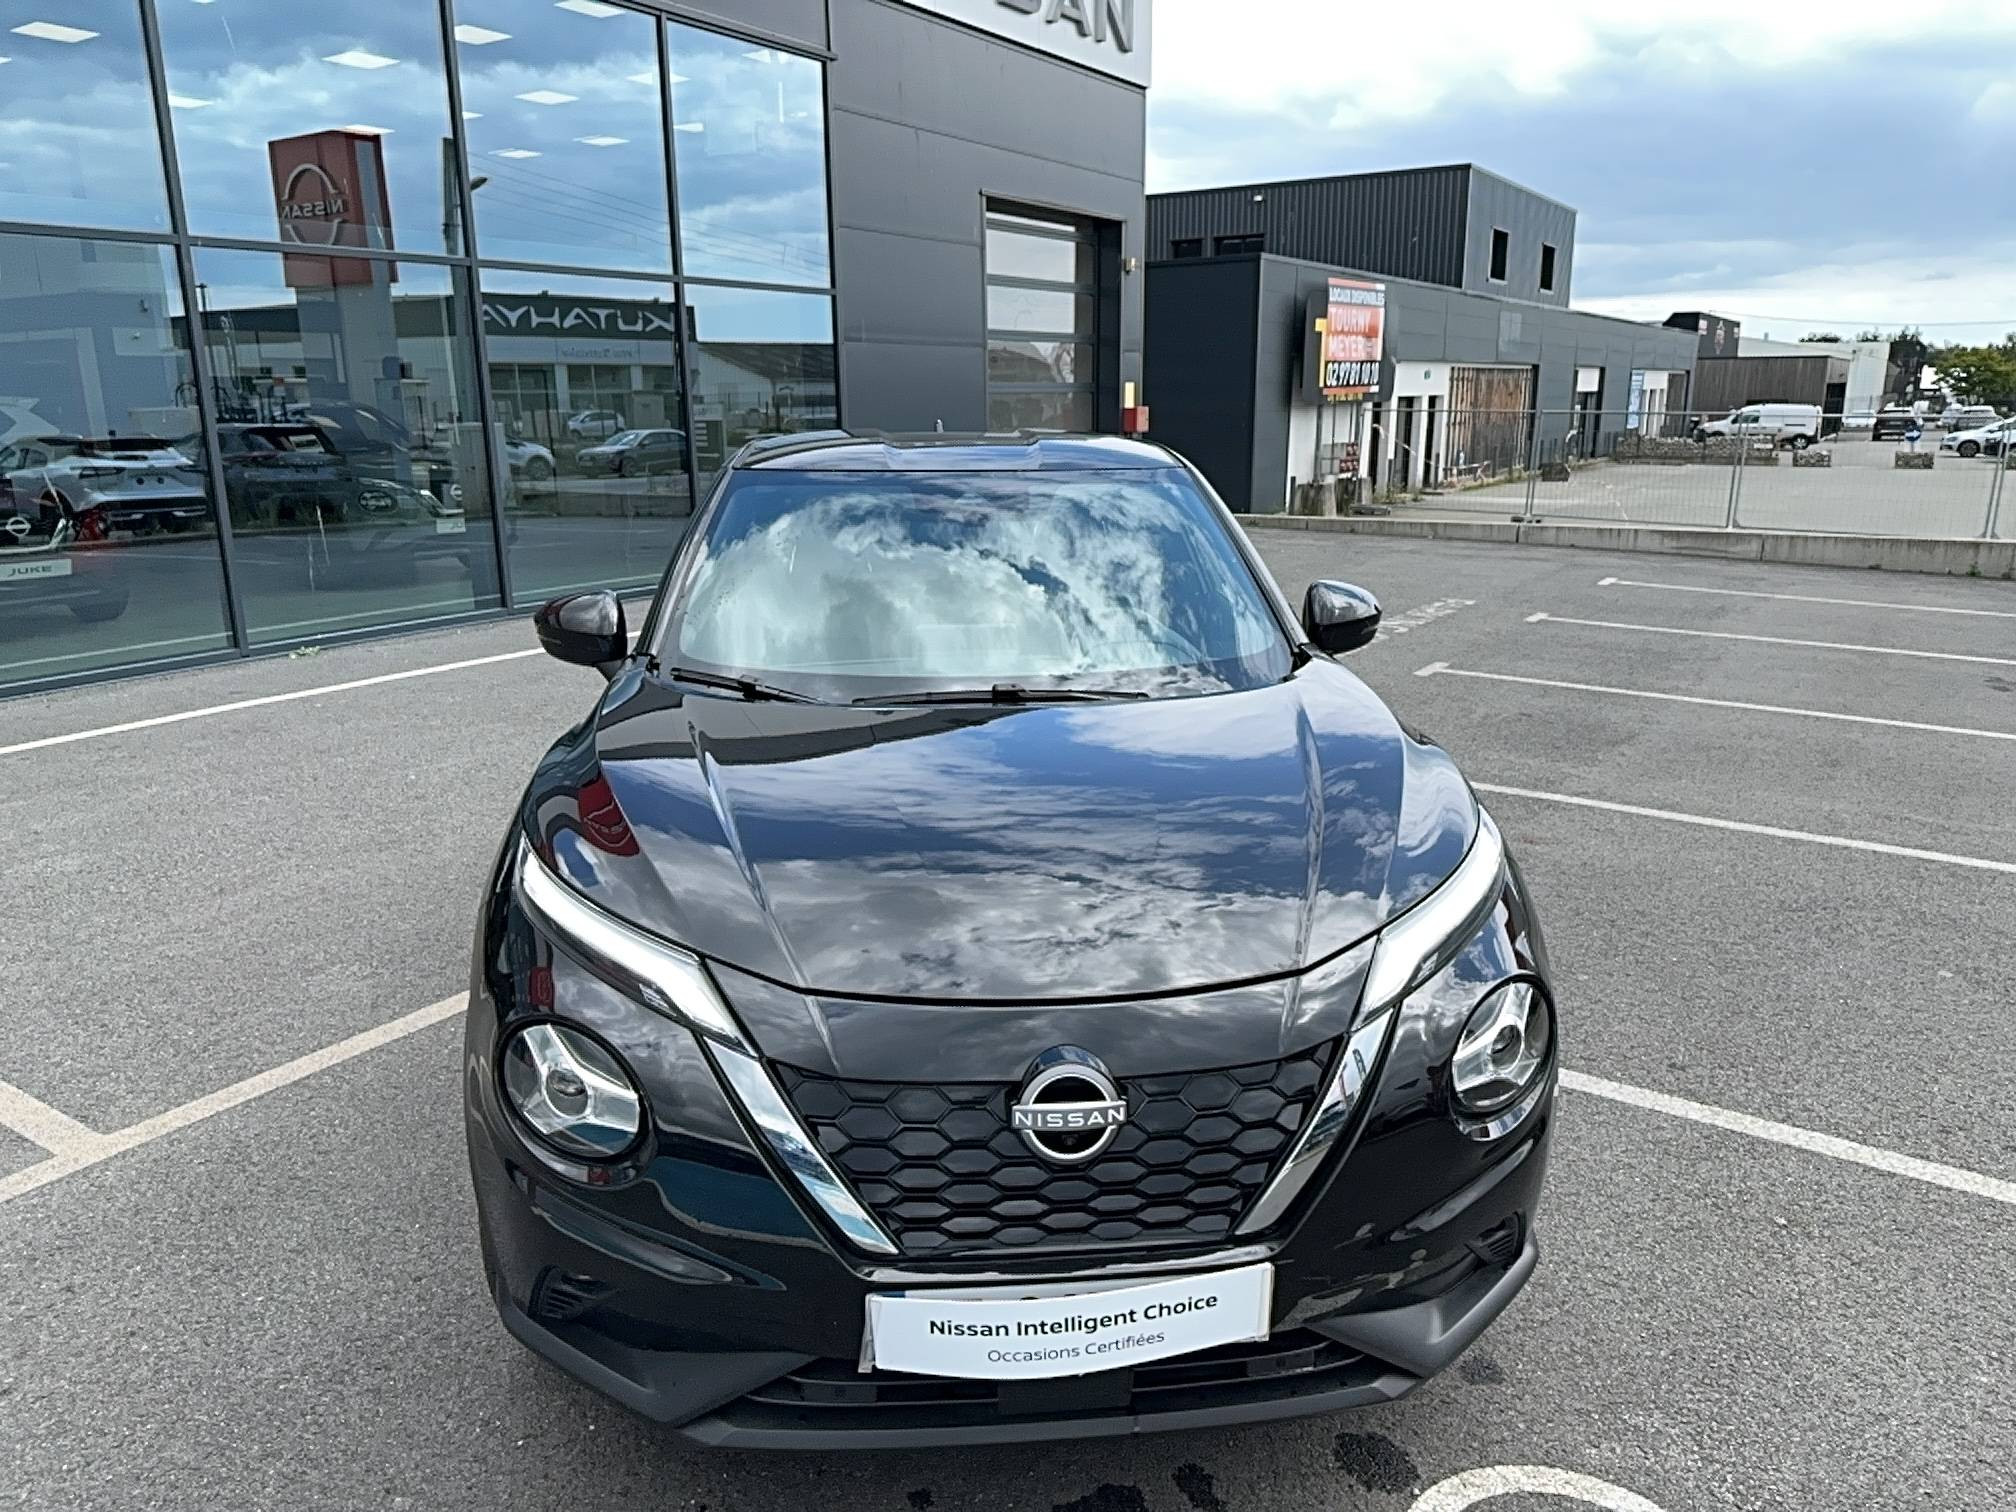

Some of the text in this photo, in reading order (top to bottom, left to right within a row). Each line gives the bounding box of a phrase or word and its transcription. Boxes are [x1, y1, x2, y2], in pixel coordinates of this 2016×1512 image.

[7, 565, 53, 577] JUKE
[1015, 1107, 1126, 1128] NISSAN
[929, 1293, 1219, 1338] Nissan Intelligent Choice
[987, 1330, 1166, 1364] Occasions Certifiées
